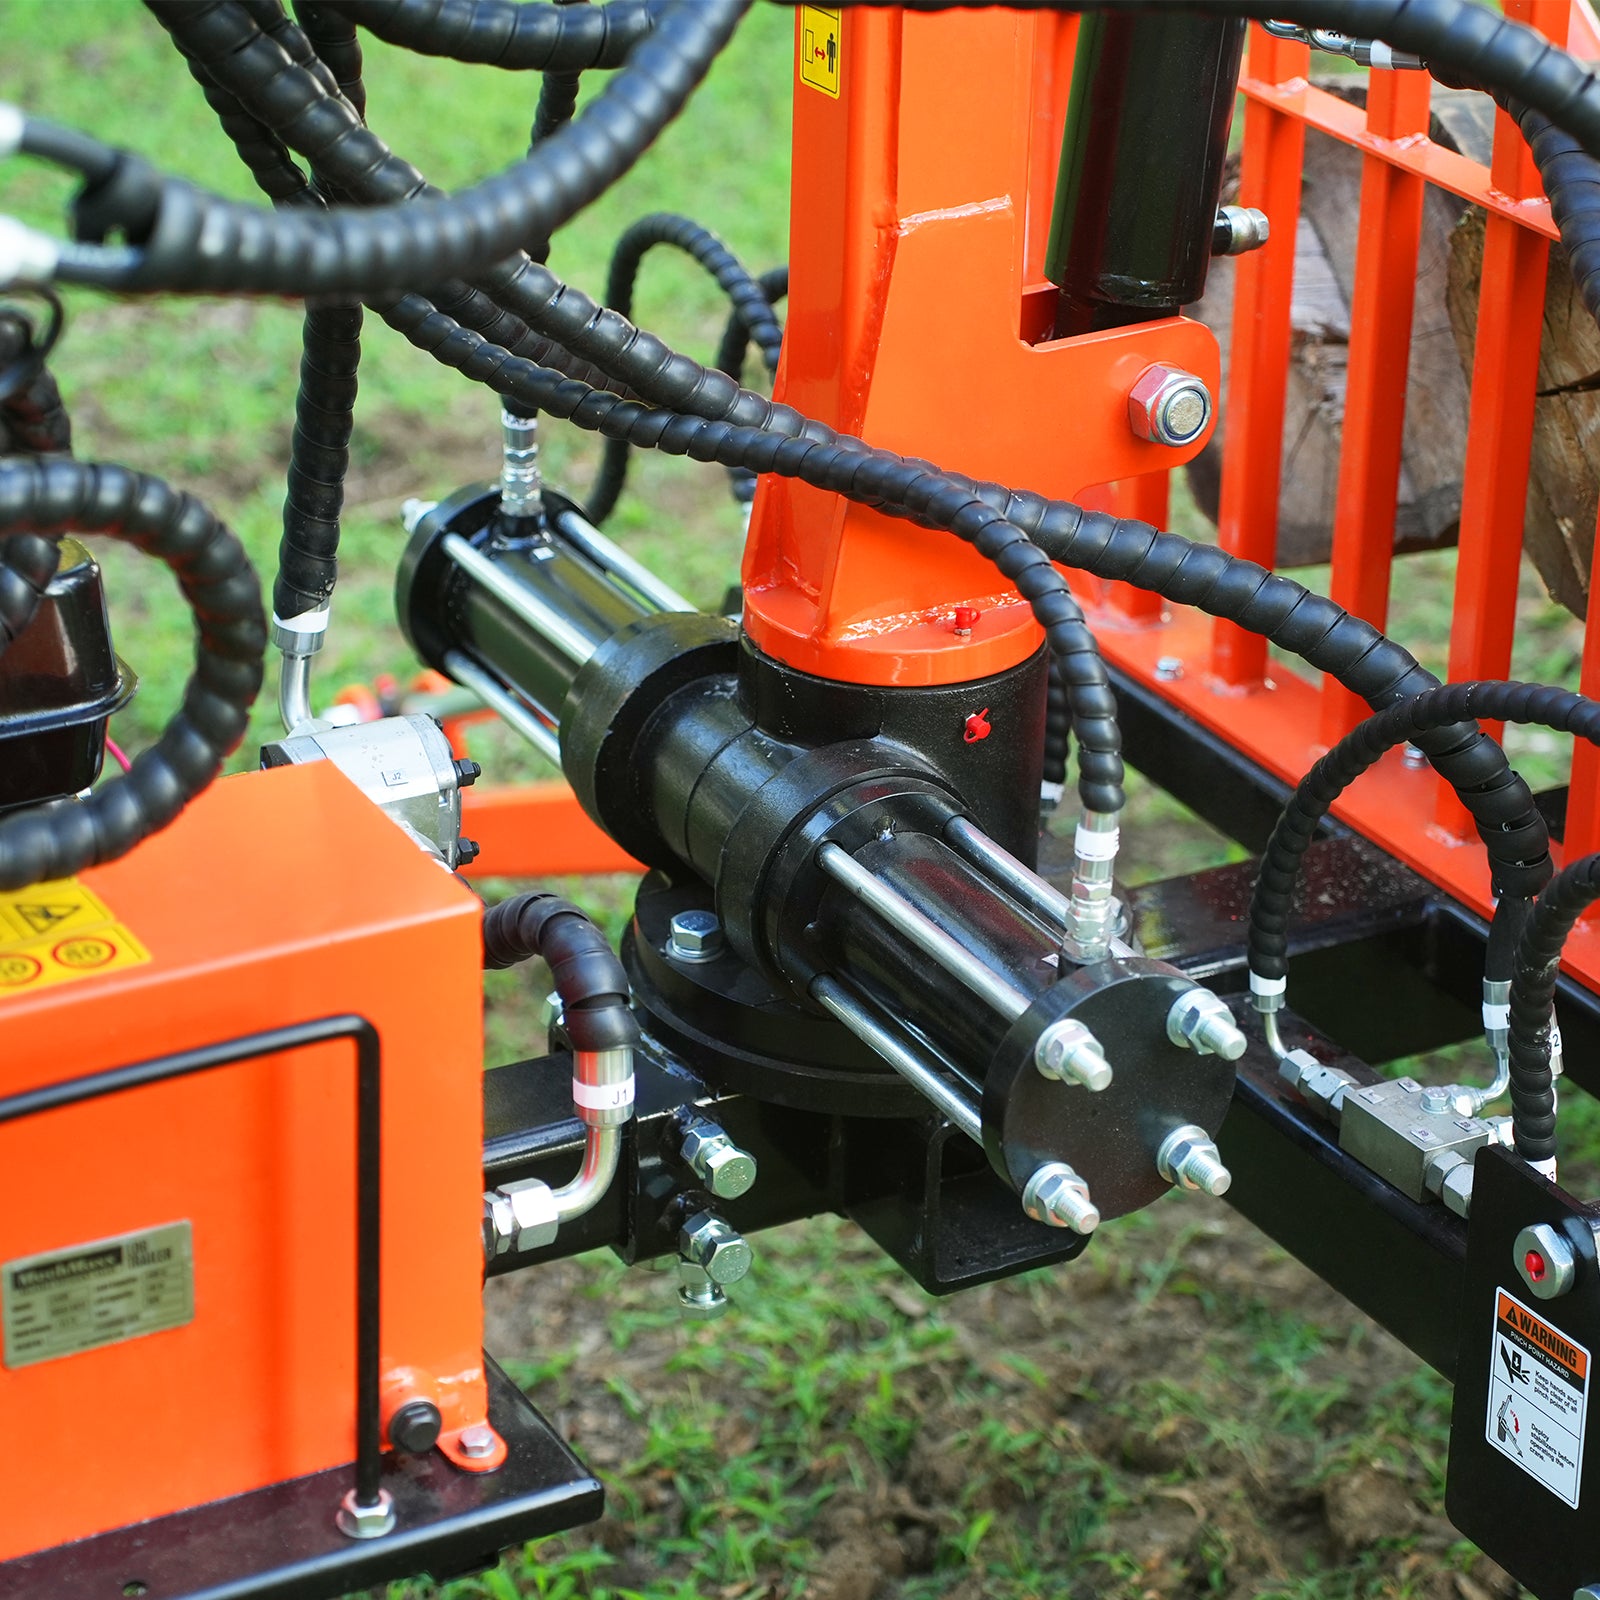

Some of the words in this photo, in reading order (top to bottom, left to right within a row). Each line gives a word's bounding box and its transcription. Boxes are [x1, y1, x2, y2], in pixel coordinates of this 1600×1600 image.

[612, 1088, 627, 1105] J1
[1510, 1331, 1527, 1347] PINCH
[1527, 1343, 1544, 1361] POINT
[1520, 1312, 1577, 1368] WARNING
[1534, 1377, 1548, 1393] limbs
[1549, 1388, 1563, 1404] clear
[1564, 1399, 1570, 1408] of
[1534, 1386, 1548, 1401] pinch
[1535, 1369, 1549, 1386] Keep
[1549, 1380, 1566, 1398] hands
[1566, 1393, 1577, 1406] and
[1531, 1423, 1549, 1442] Deploy
[1530, 1430, 1556, 1455] stabilizers
[1558, 1451, 1574, 1468] before
[1530, 1439, 1554, 1462] operating
[1555, 1457, 1563, 1468] the
